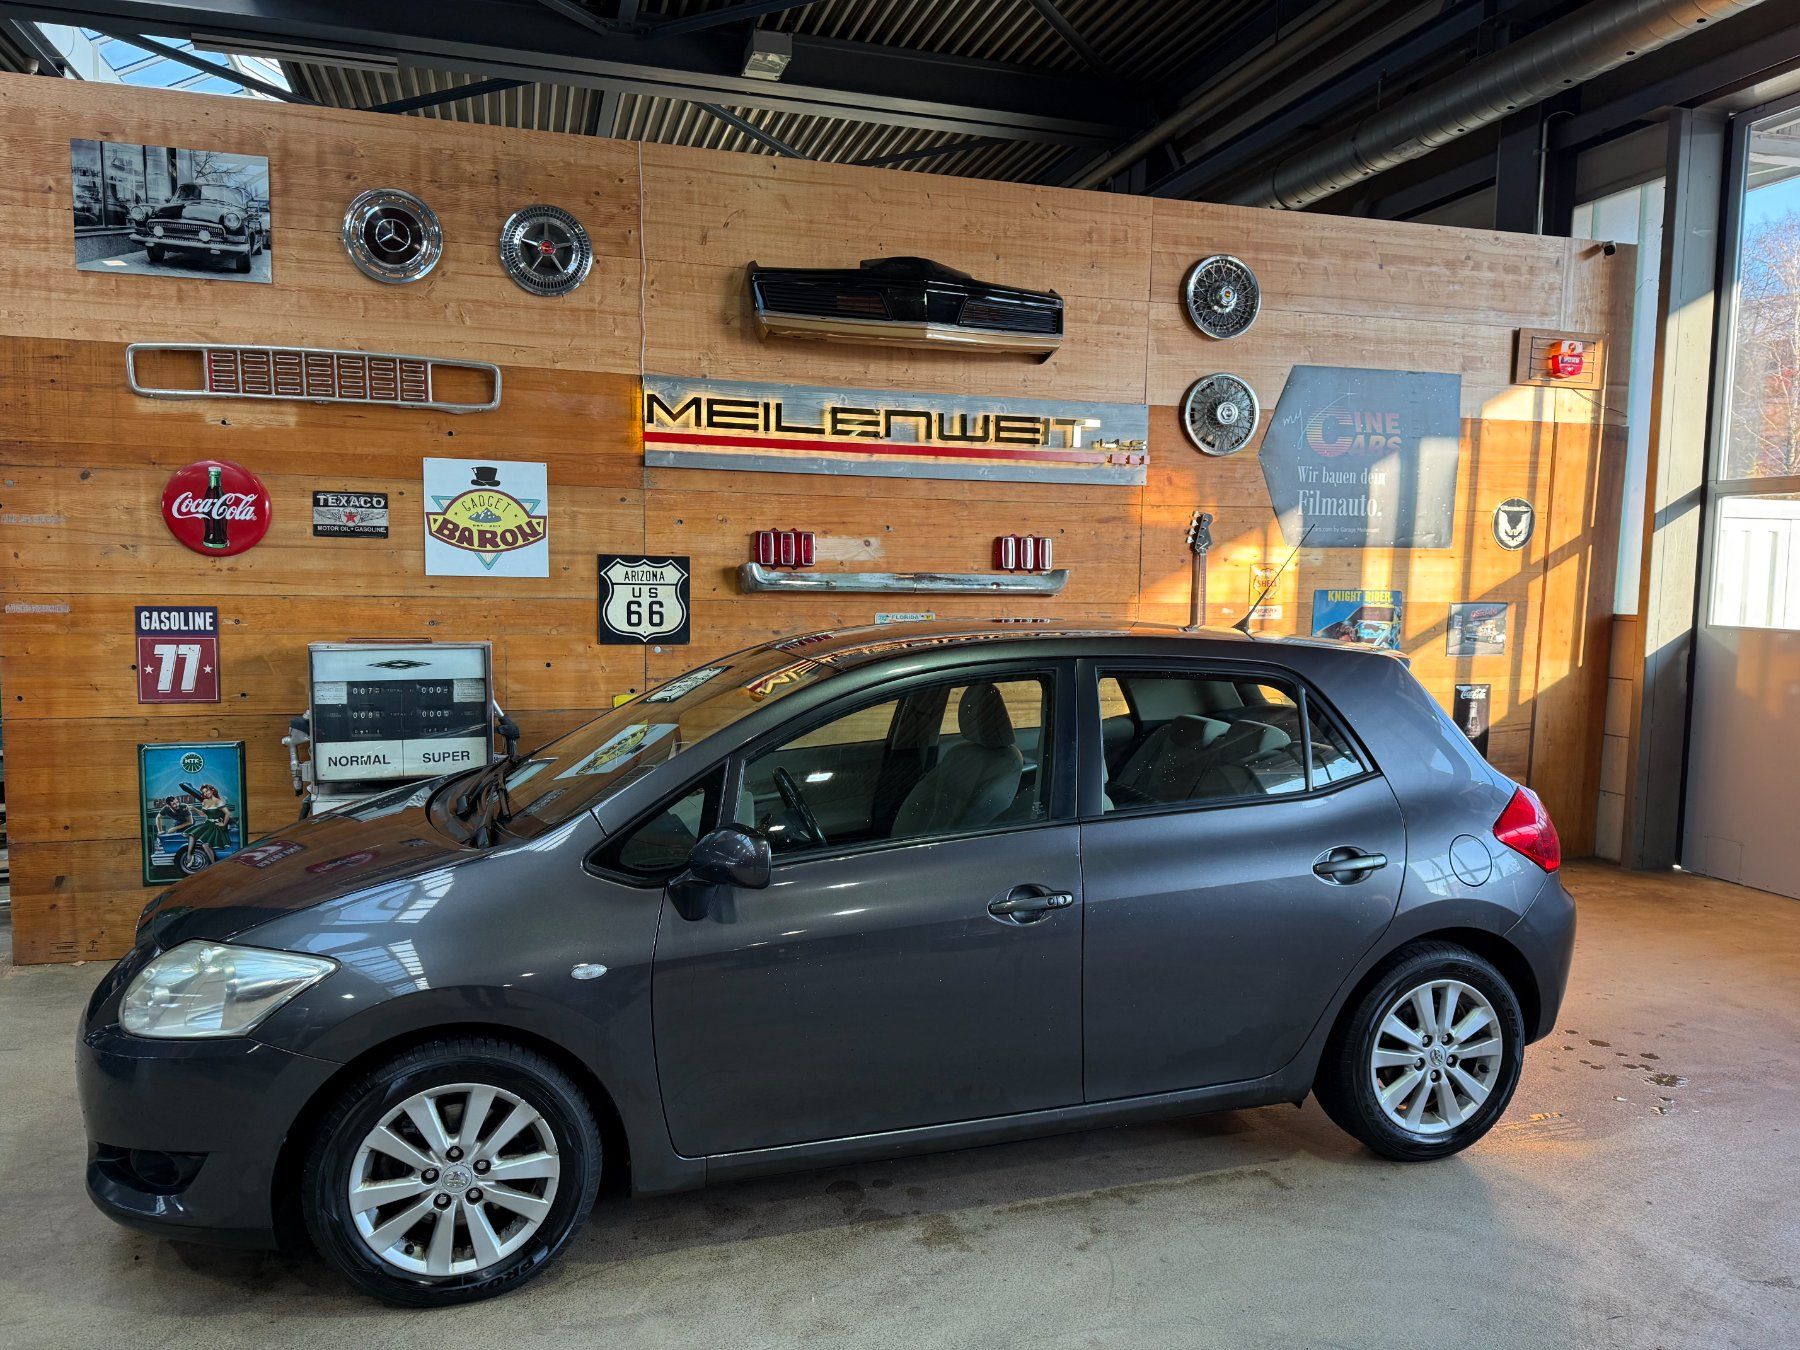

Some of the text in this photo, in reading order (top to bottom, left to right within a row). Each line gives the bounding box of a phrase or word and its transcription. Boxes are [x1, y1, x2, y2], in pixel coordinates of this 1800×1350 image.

[646, 393, 1101, 448] MEILENWEIT
[1297, 465, 1387, 487] Wir bauen dein
[171, 491, 258, 521] Coca-Cola
[316, 495, 386, 508] TEXACO
[461, 494, 512, 513] GADGET
[1296, 489, 1383, 517] Filmauto.
[433, 516, 543, 549] BARON
[623, 570, 665, 582] ARIZONA
[1327, 590, 1363, 603] KNIGHT
[140, 611, 214, 631] GASOLINE
[626, 600, 665, 627] 66
[153, 643, 202, 693] 77
[327, 750, 471, 767] NORMAL SUPER
